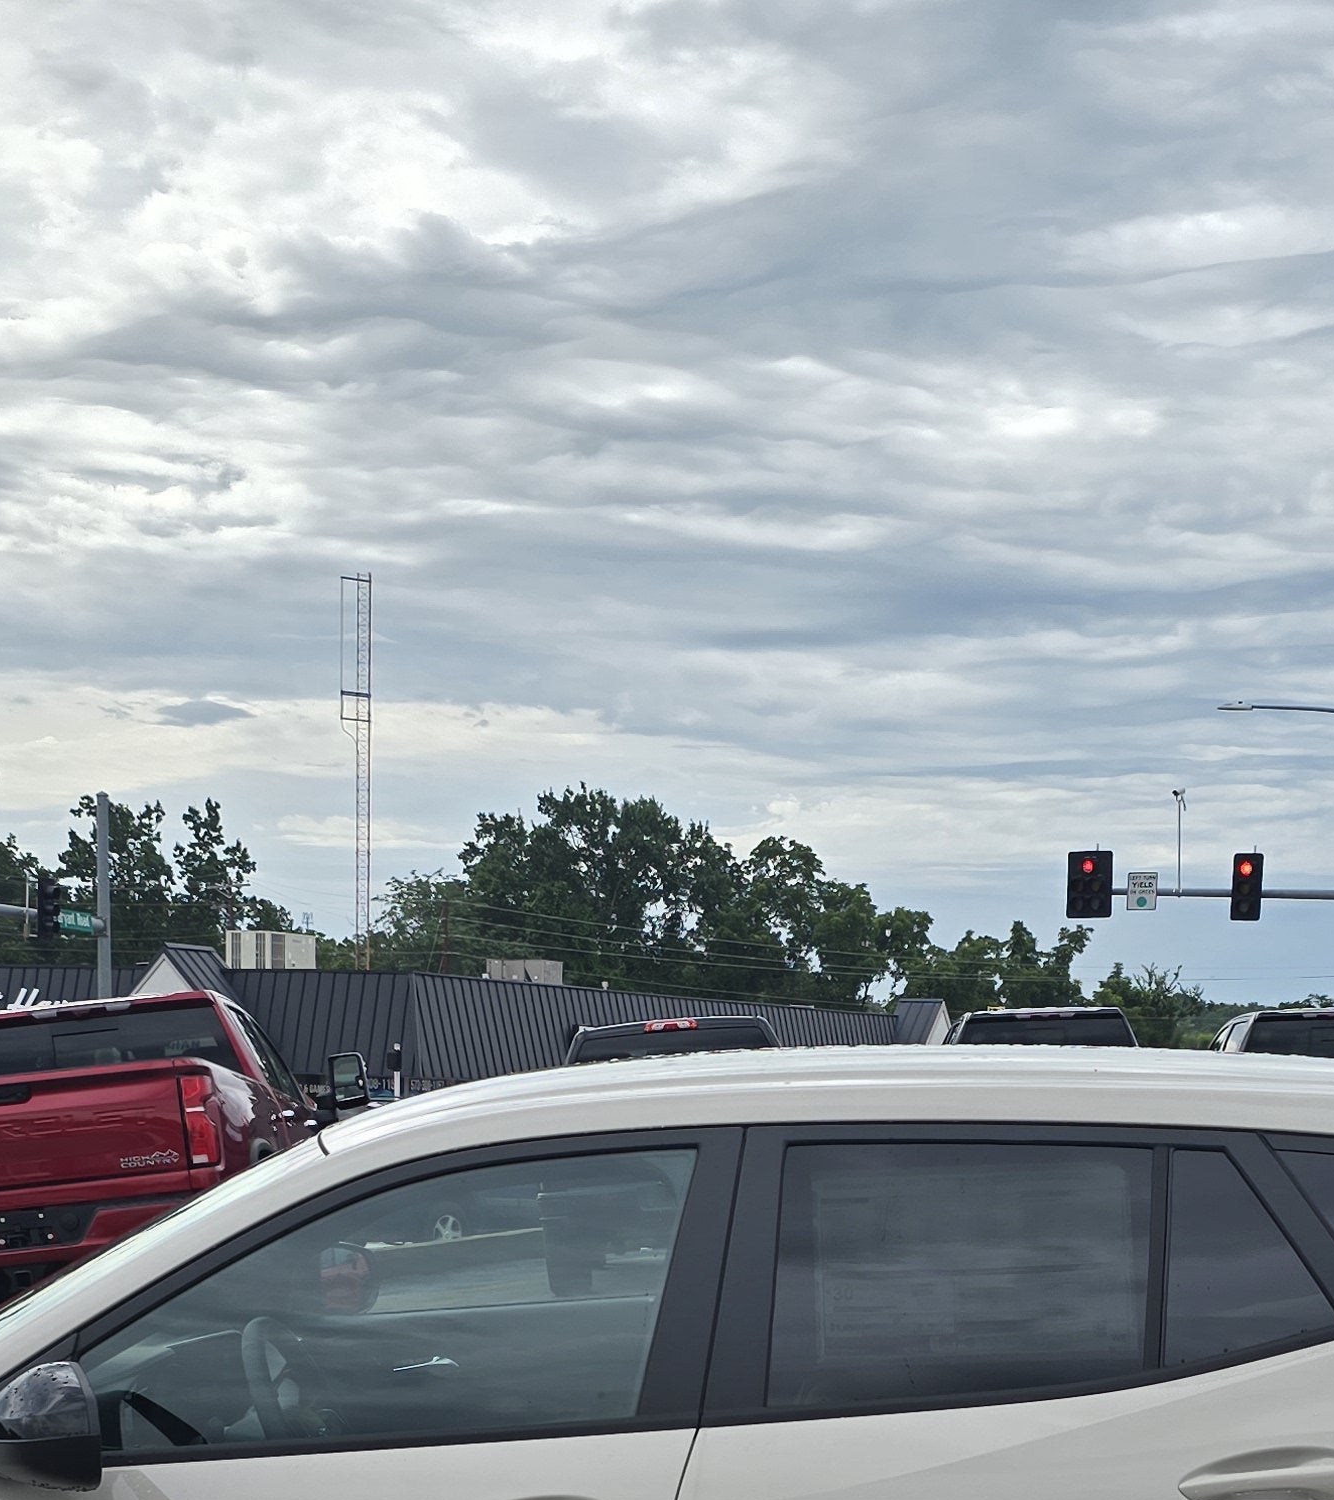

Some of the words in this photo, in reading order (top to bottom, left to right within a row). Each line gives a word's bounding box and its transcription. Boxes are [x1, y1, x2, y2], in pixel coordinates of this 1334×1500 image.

[77, 912, 91, 927] Road
[119, 1154, 150, 1162] HIGH
[120, 1156, 179, 1168] COUNTRY
